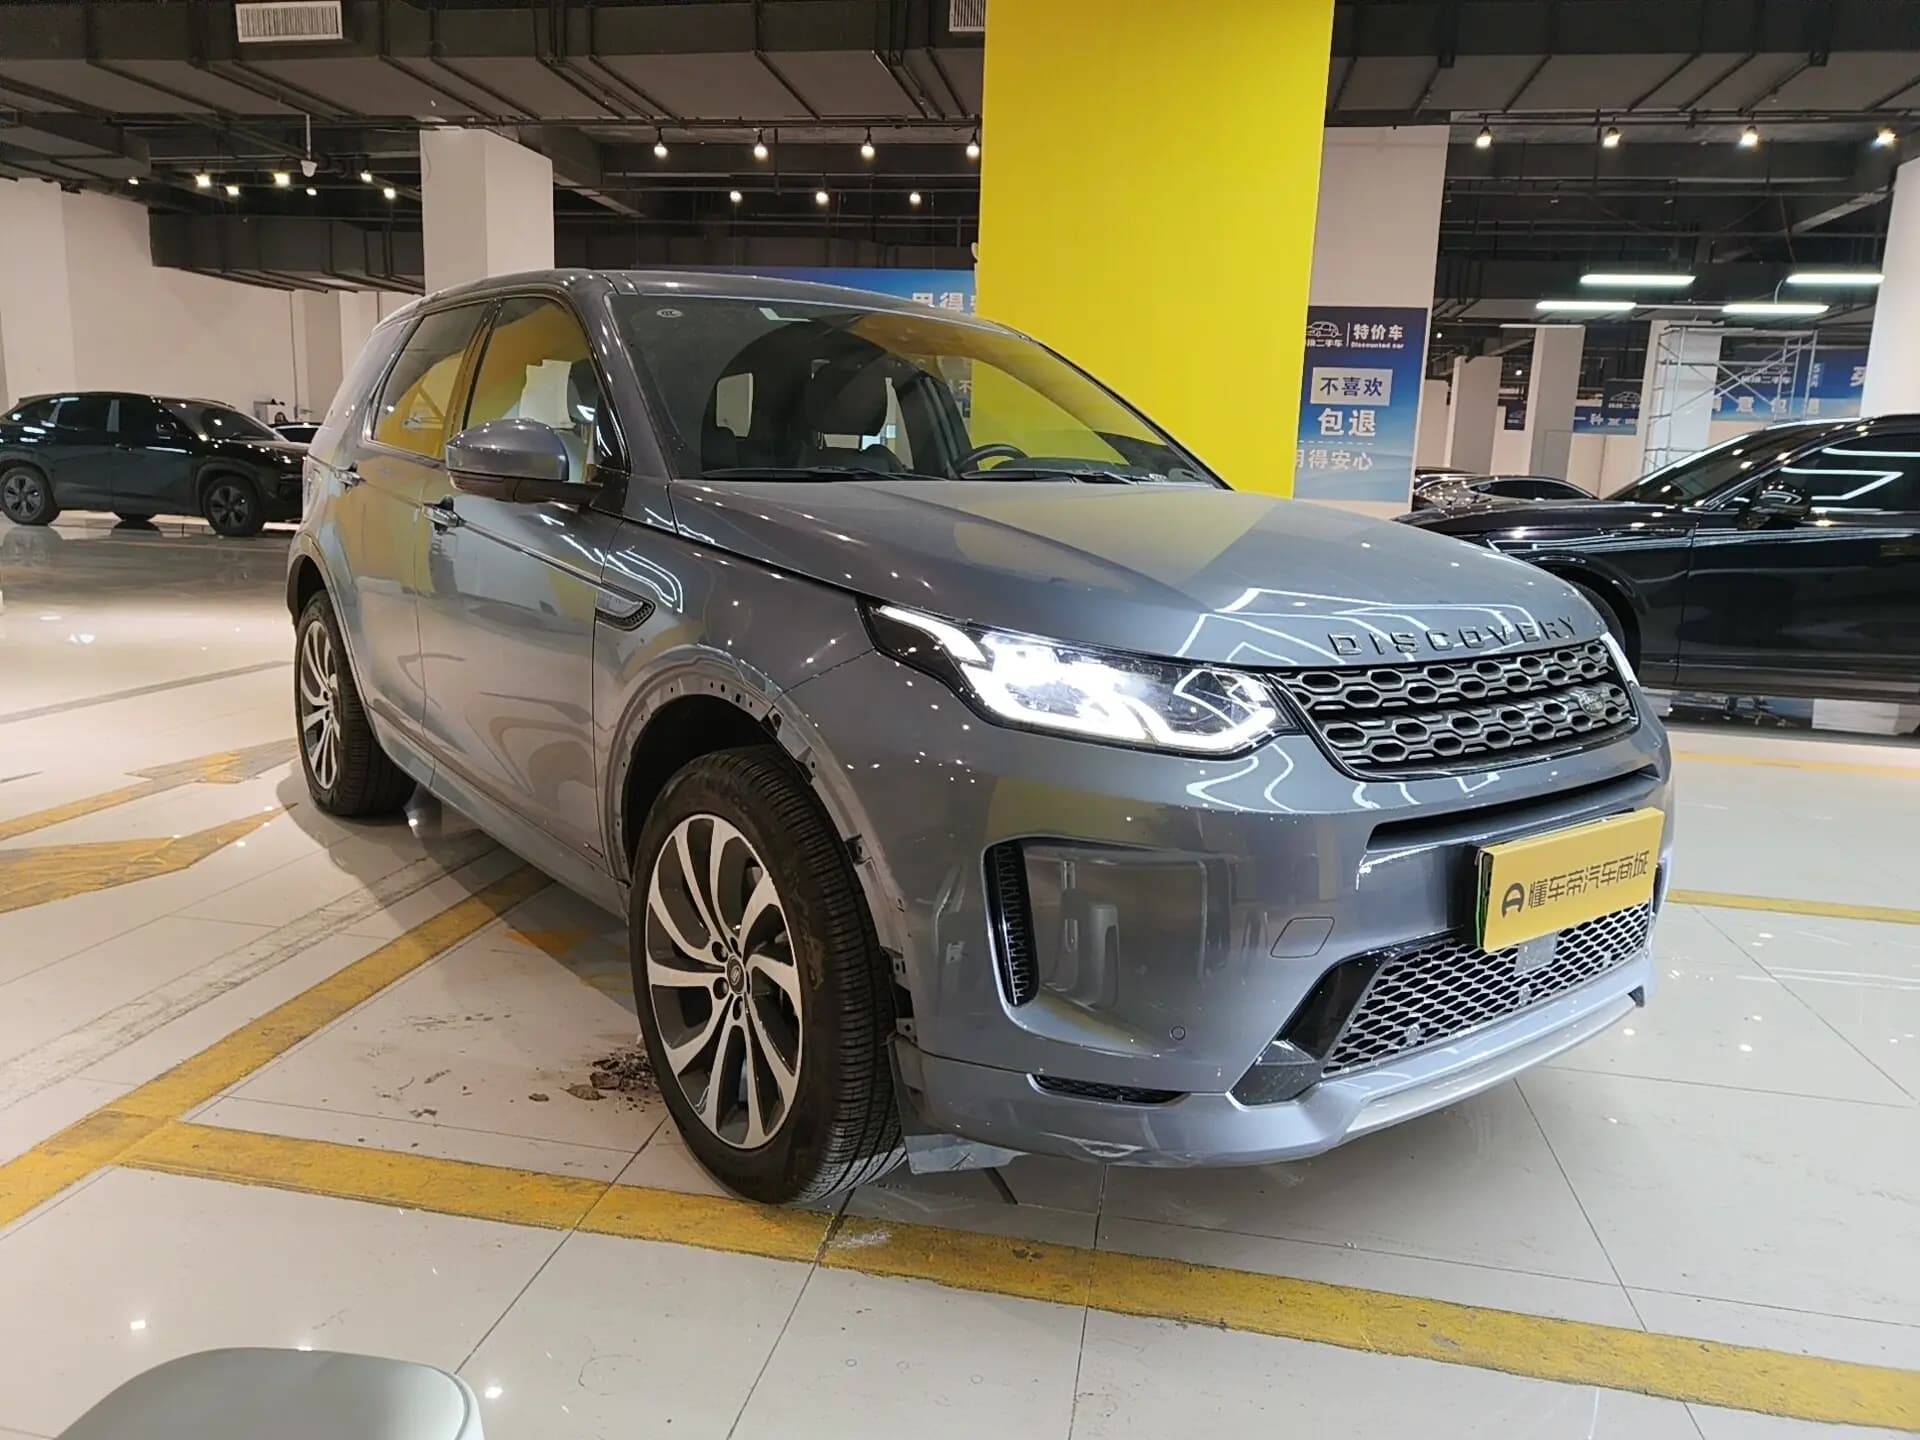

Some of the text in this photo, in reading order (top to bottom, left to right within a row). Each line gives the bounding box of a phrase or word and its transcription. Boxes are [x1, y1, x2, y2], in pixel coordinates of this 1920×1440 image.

[1353, 323, 1404, 340] 特价车
[1319, 376, 1384, 397] 不喜欢
[1317, 407, 1377, 437] 包退
[1327, 616, 1577, 657] DISCOVERY
